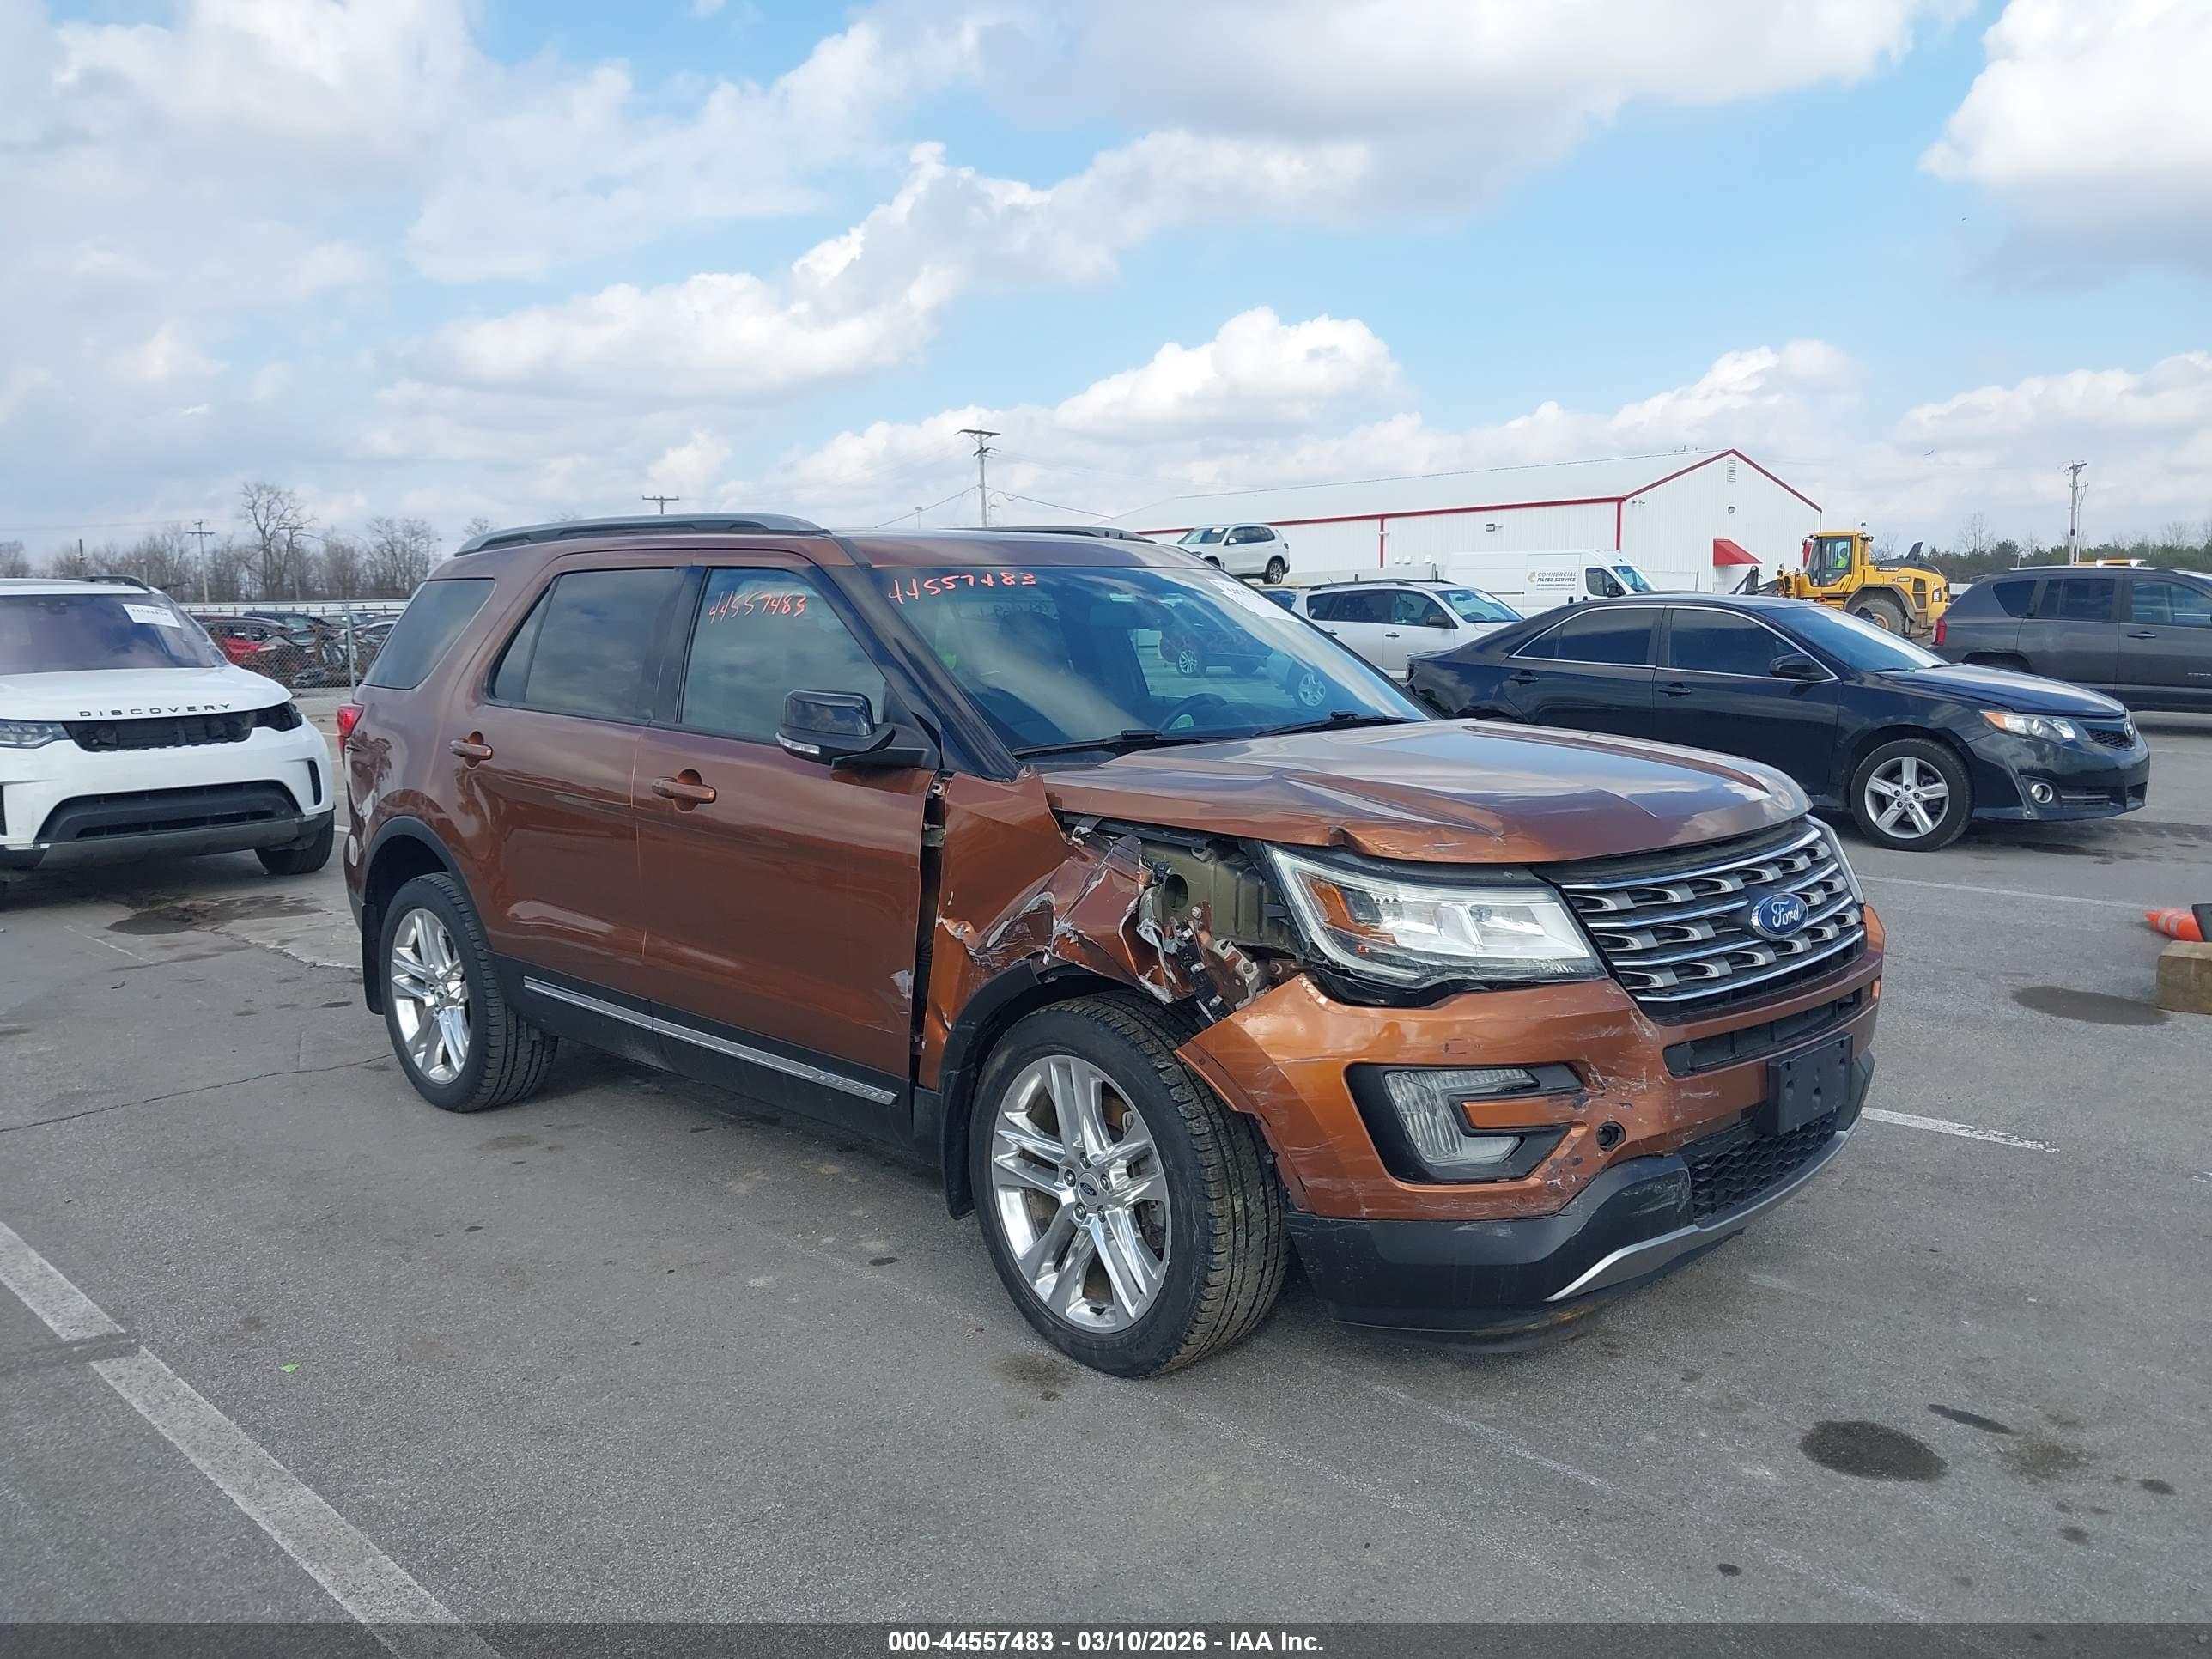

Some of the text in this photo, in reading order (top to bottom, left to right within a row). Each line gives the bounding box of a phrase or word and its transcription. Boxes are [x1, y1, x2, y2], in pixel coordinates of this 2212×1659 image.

[888, 572, 1037, 605] 44557483
[708, 590, 806, 624] 44557483
[79, 703, 230, 718] DISCOVERY
[1771, 900, 1802, 927] Ford
